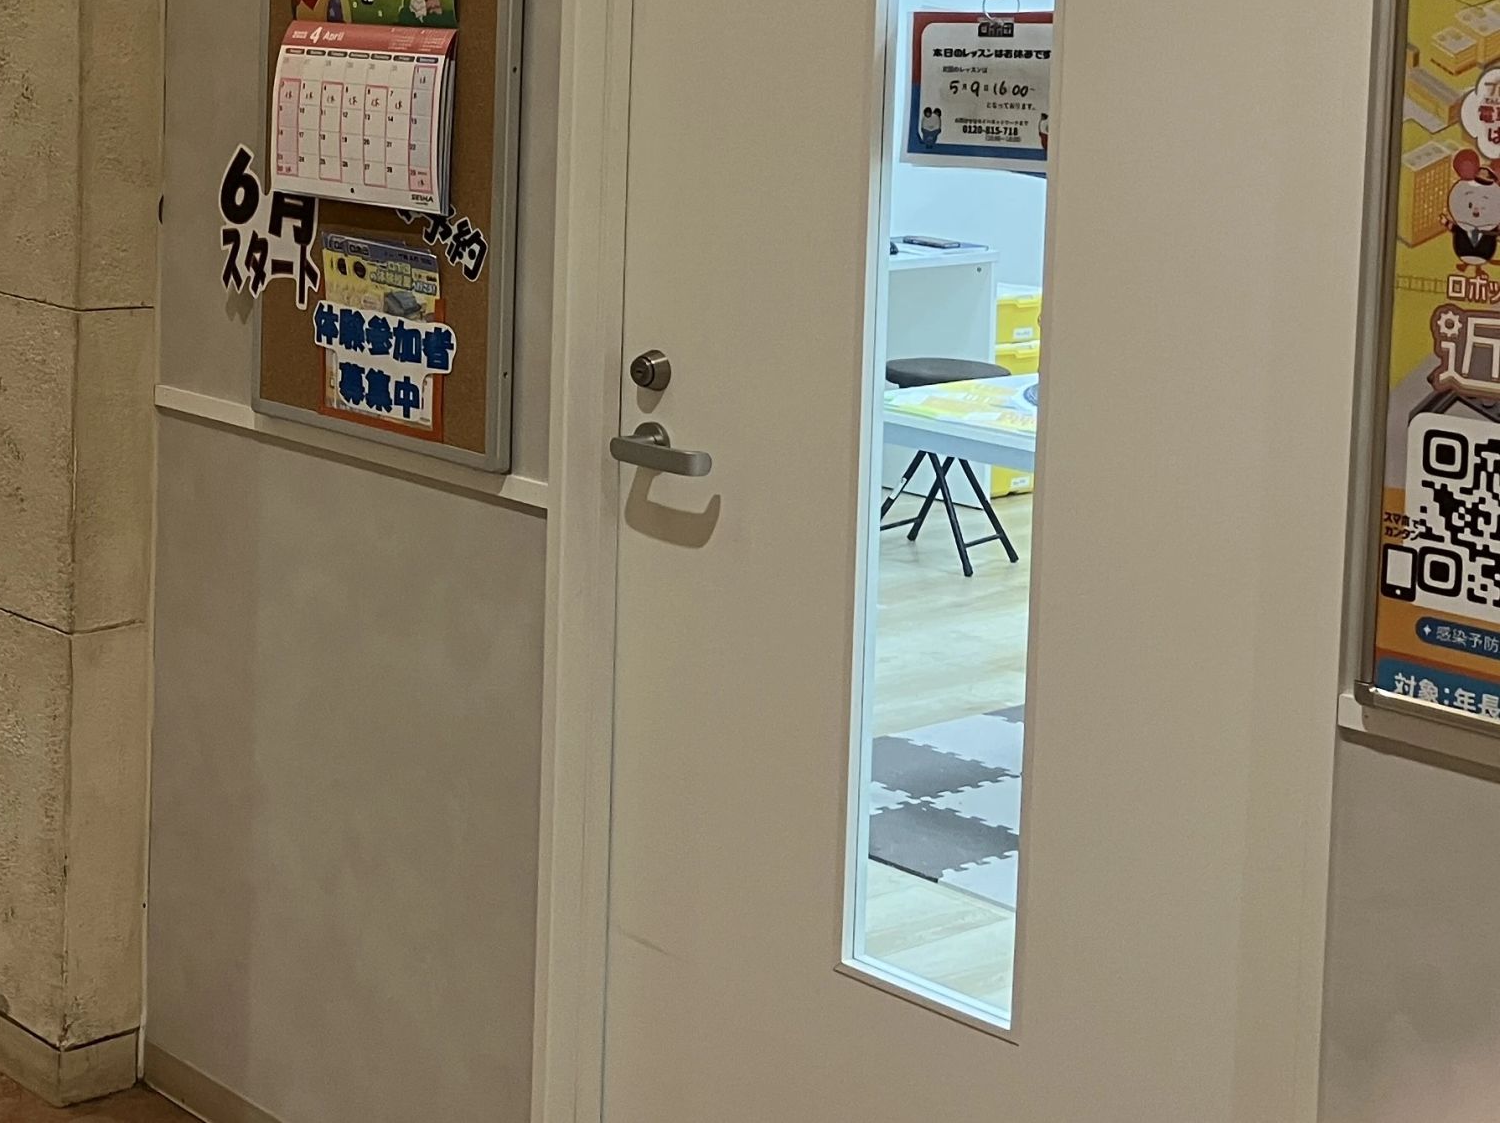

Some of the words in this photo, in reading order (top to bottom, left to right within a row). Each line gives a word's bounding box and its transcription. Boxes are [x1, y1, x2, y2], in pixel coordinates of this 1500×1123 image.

[310, 26, 323, 44] 4
[322, 30, 344, 42] April
[933, 48, 1051, 59] 本日のレッスンはお休みです
[220, 147, 315, 245] 6月
[221, 227, 319, 306] スタート
[315, 302, 454, 370] 体験参加者
[339, 362, 420, 419] 募集中
[1384, 512, 1419, 528] スマホで
[1384, 527, 1421, 541] カンタン
